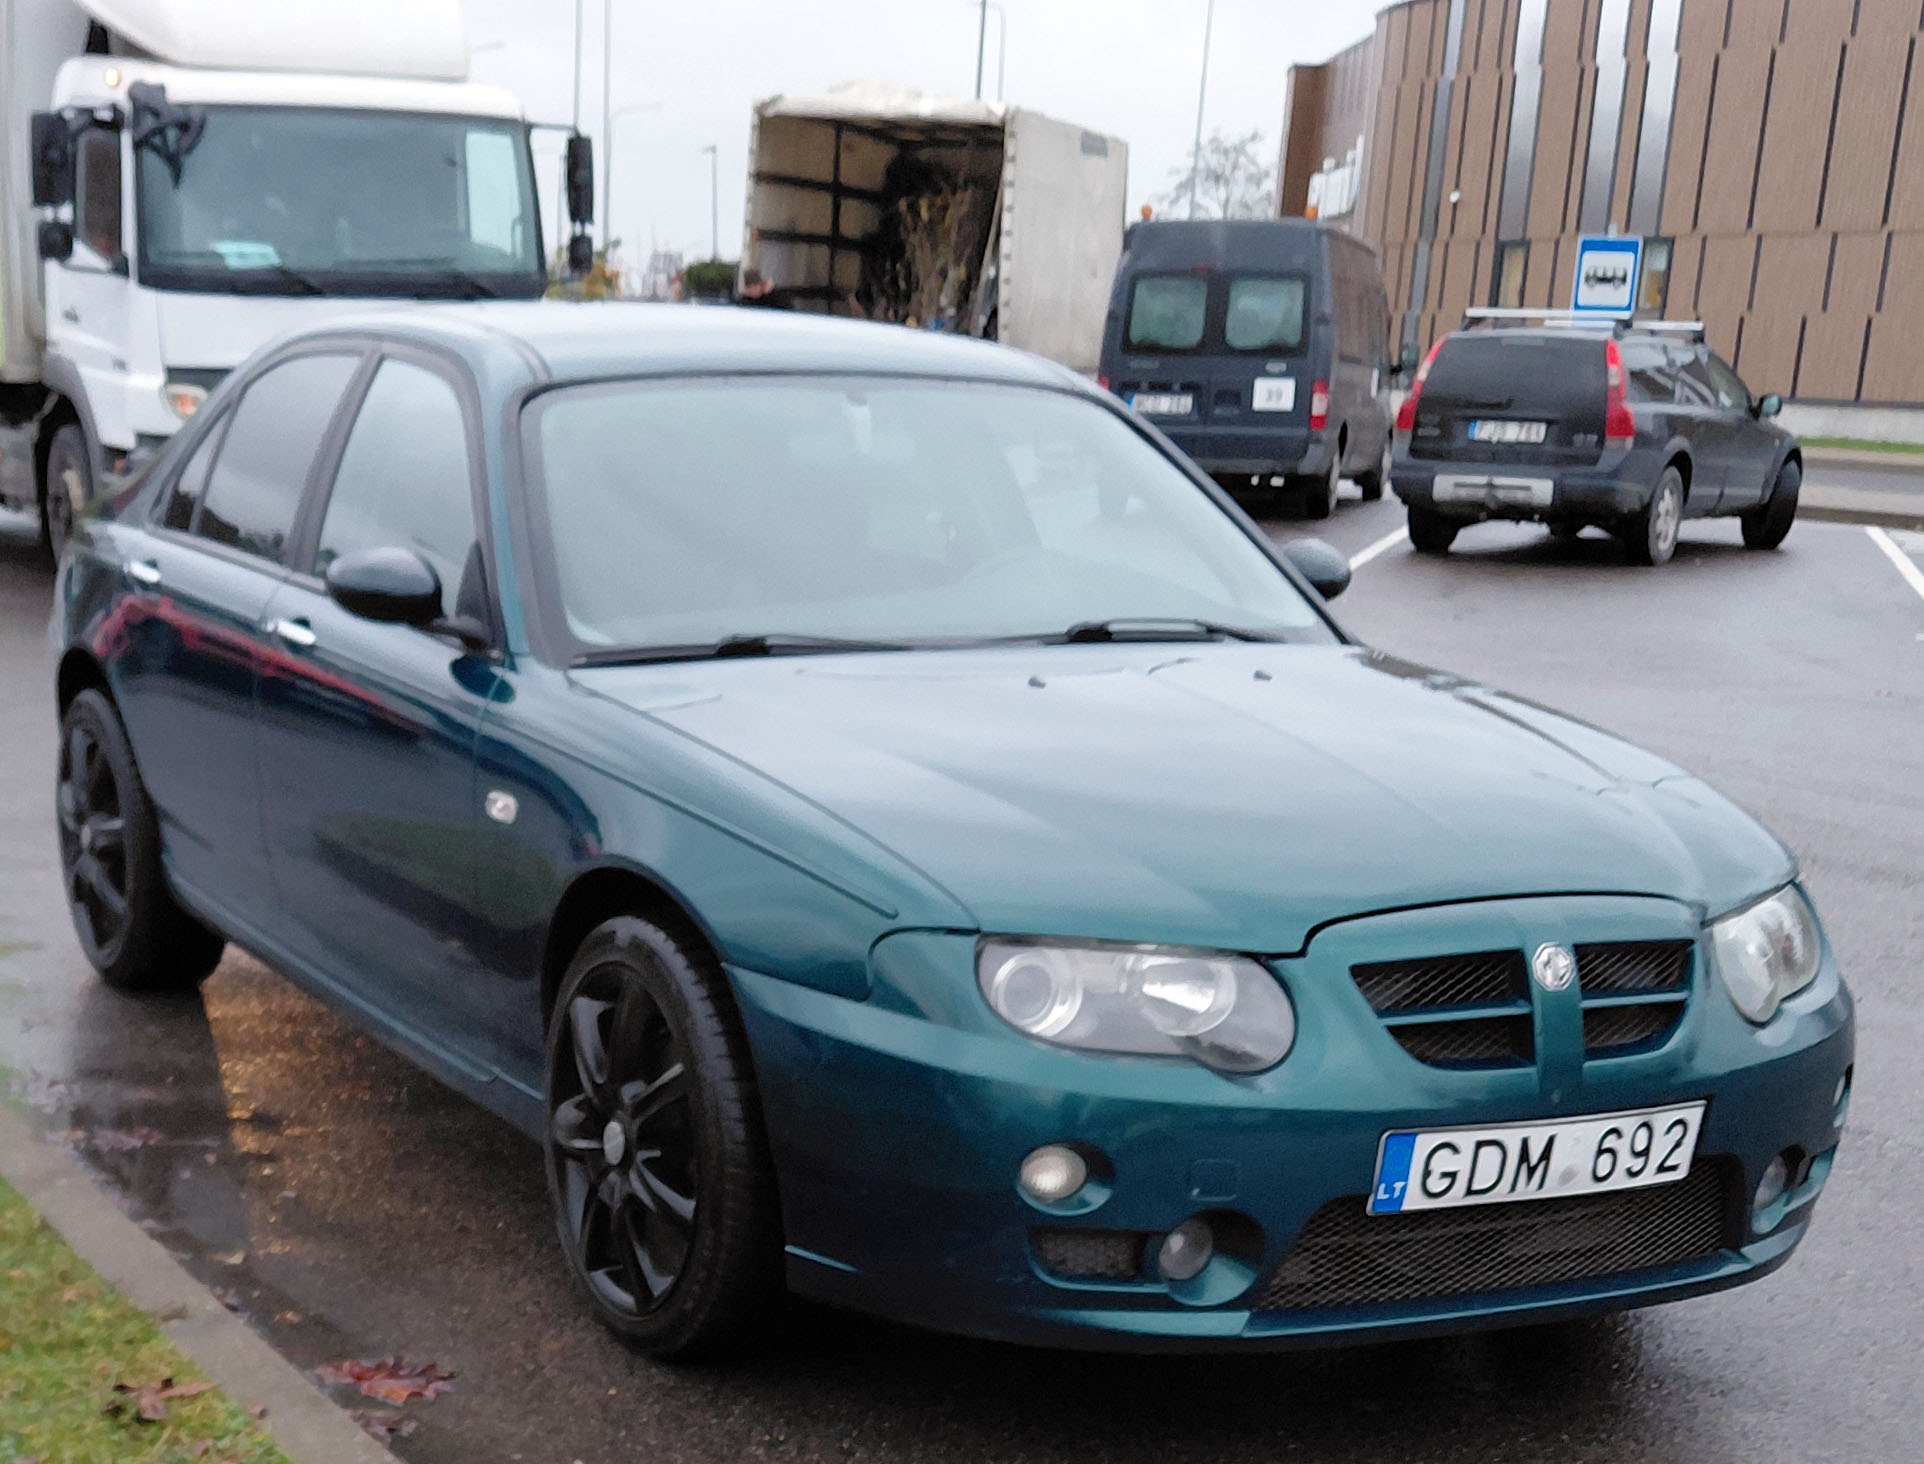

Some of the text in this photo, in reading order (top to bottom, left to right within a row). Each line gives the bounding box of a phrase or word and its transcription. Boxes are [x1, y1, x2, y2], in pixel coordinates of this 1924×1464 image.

[1421, 1118, 1689, 1198] GDM 692
[1376, 1182, 1406, 1199] LT
